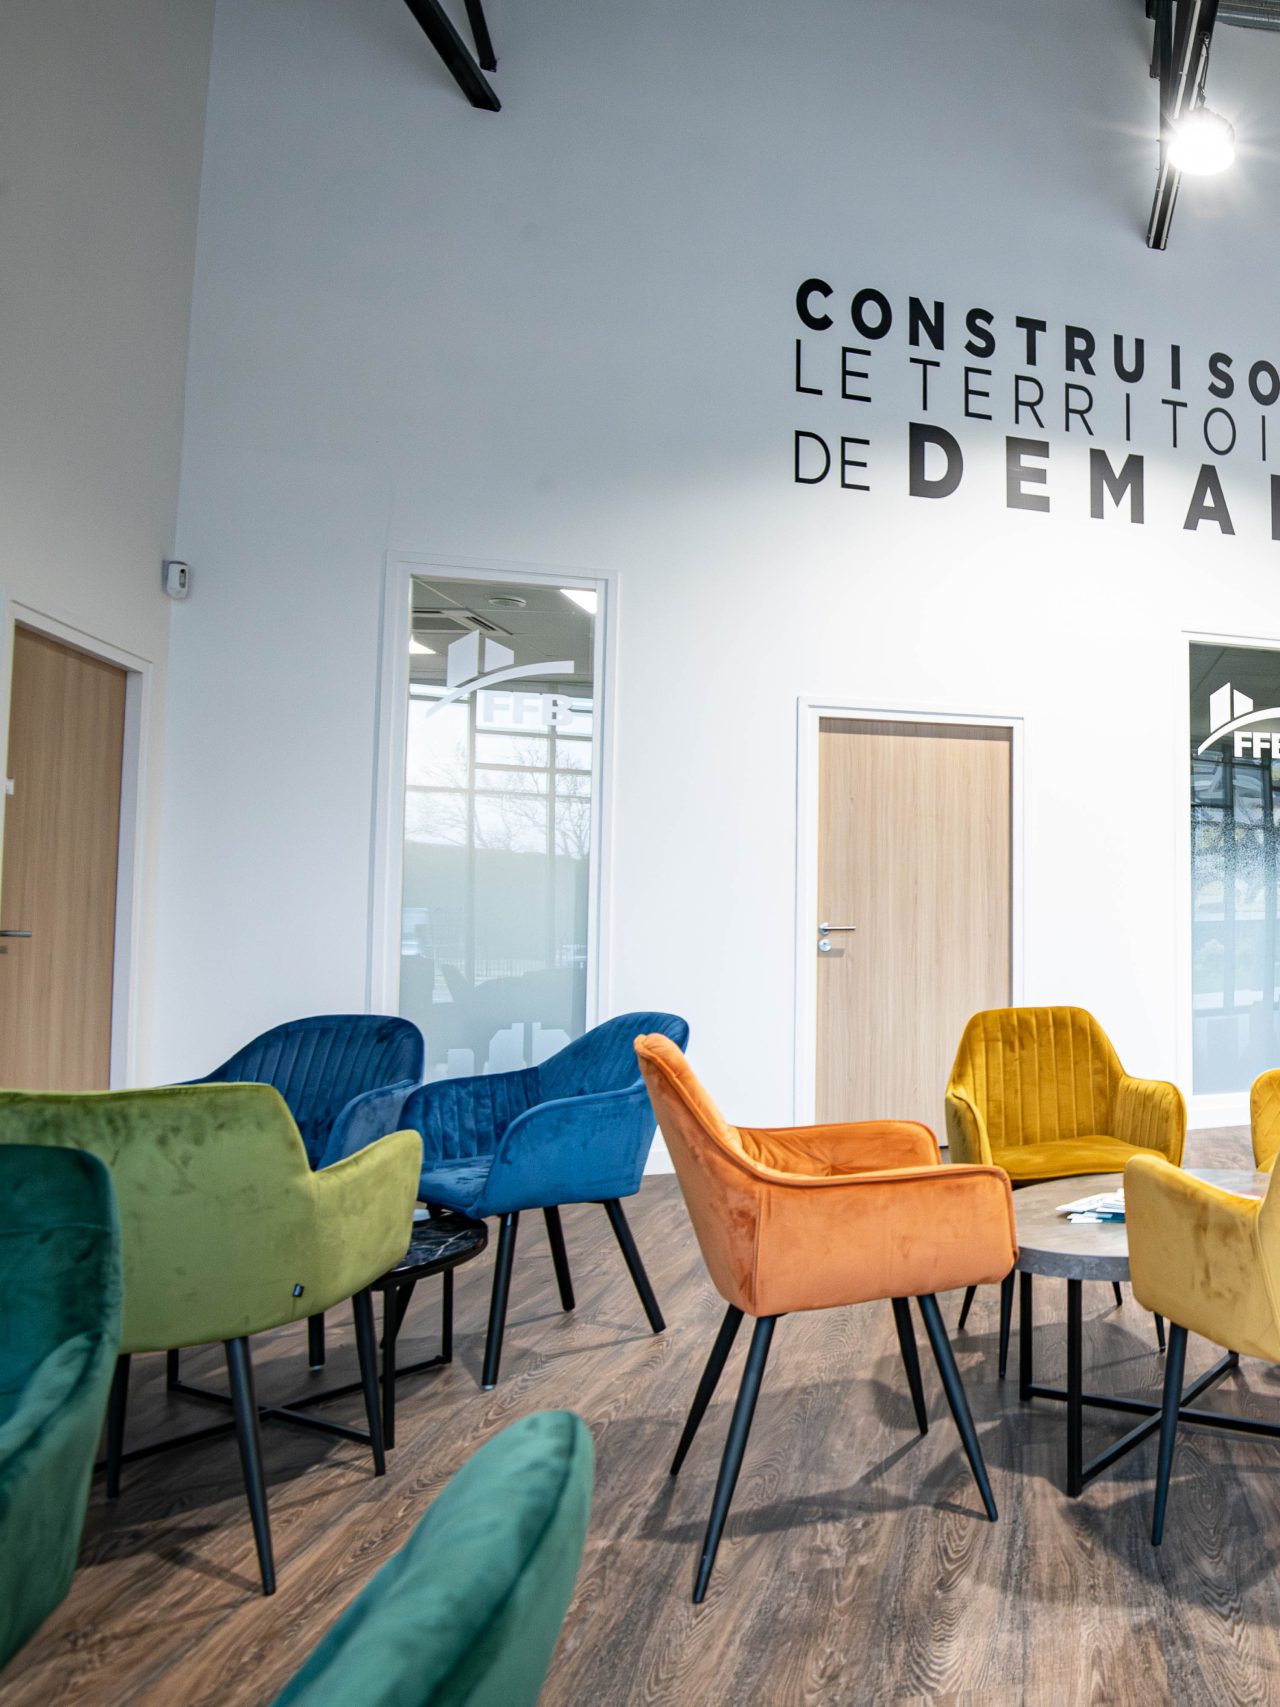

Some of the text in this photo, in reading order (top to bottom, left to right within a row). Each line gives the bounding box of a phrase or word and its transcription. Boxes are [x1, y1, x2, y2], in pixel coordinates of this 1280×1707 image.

[796, 339, 873, 403] LE
[794, 430, 870, 491] DE
[483, 690, 573, 726] FFB
